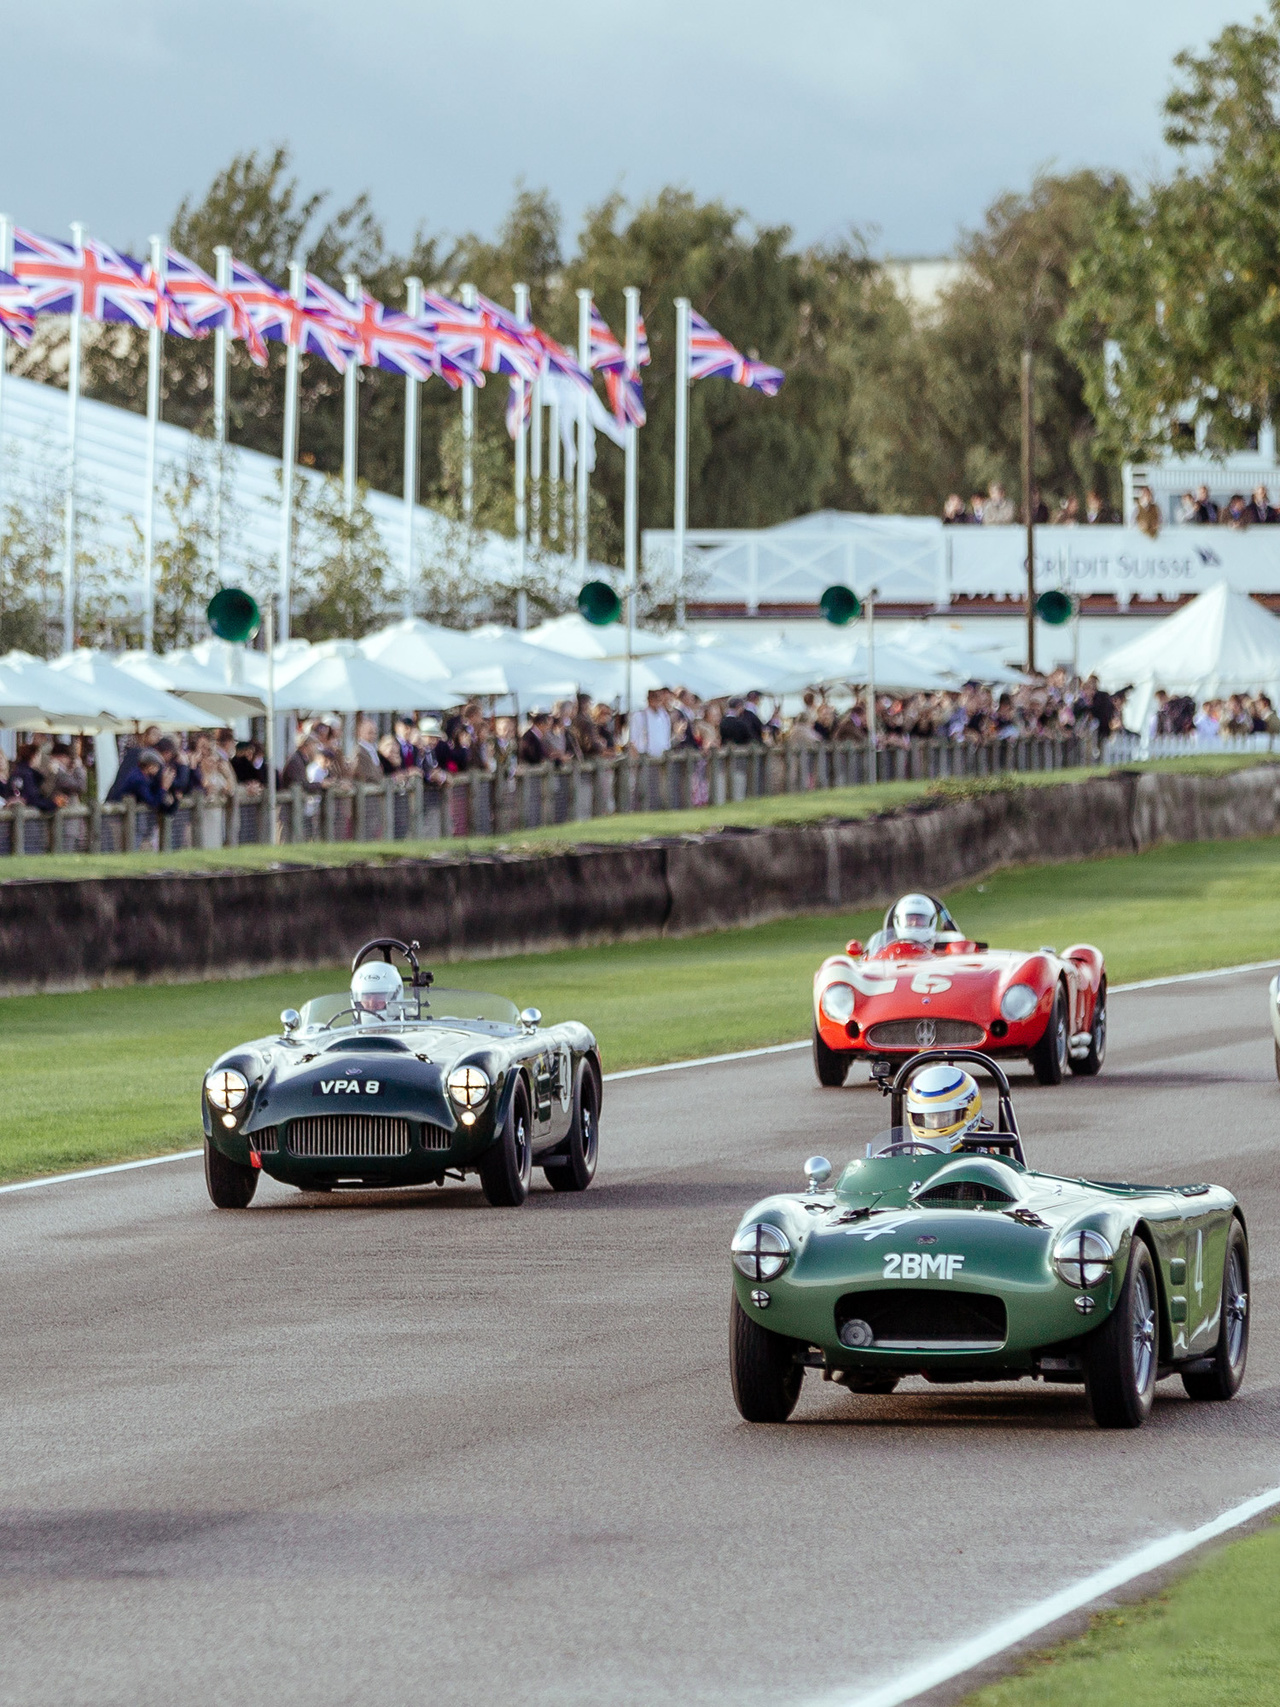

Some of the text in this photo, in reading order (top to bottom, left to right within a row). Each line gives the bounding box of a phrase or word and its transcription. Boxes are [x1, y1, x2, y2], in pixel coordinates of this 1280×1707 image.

[320, 1080, 380, 1095] VPA 8
[845, 1215, 922, 1241] 4
[883, 1252, 965, 1280] 2BMF
[1194, 1228, 1204, 1308] 4
